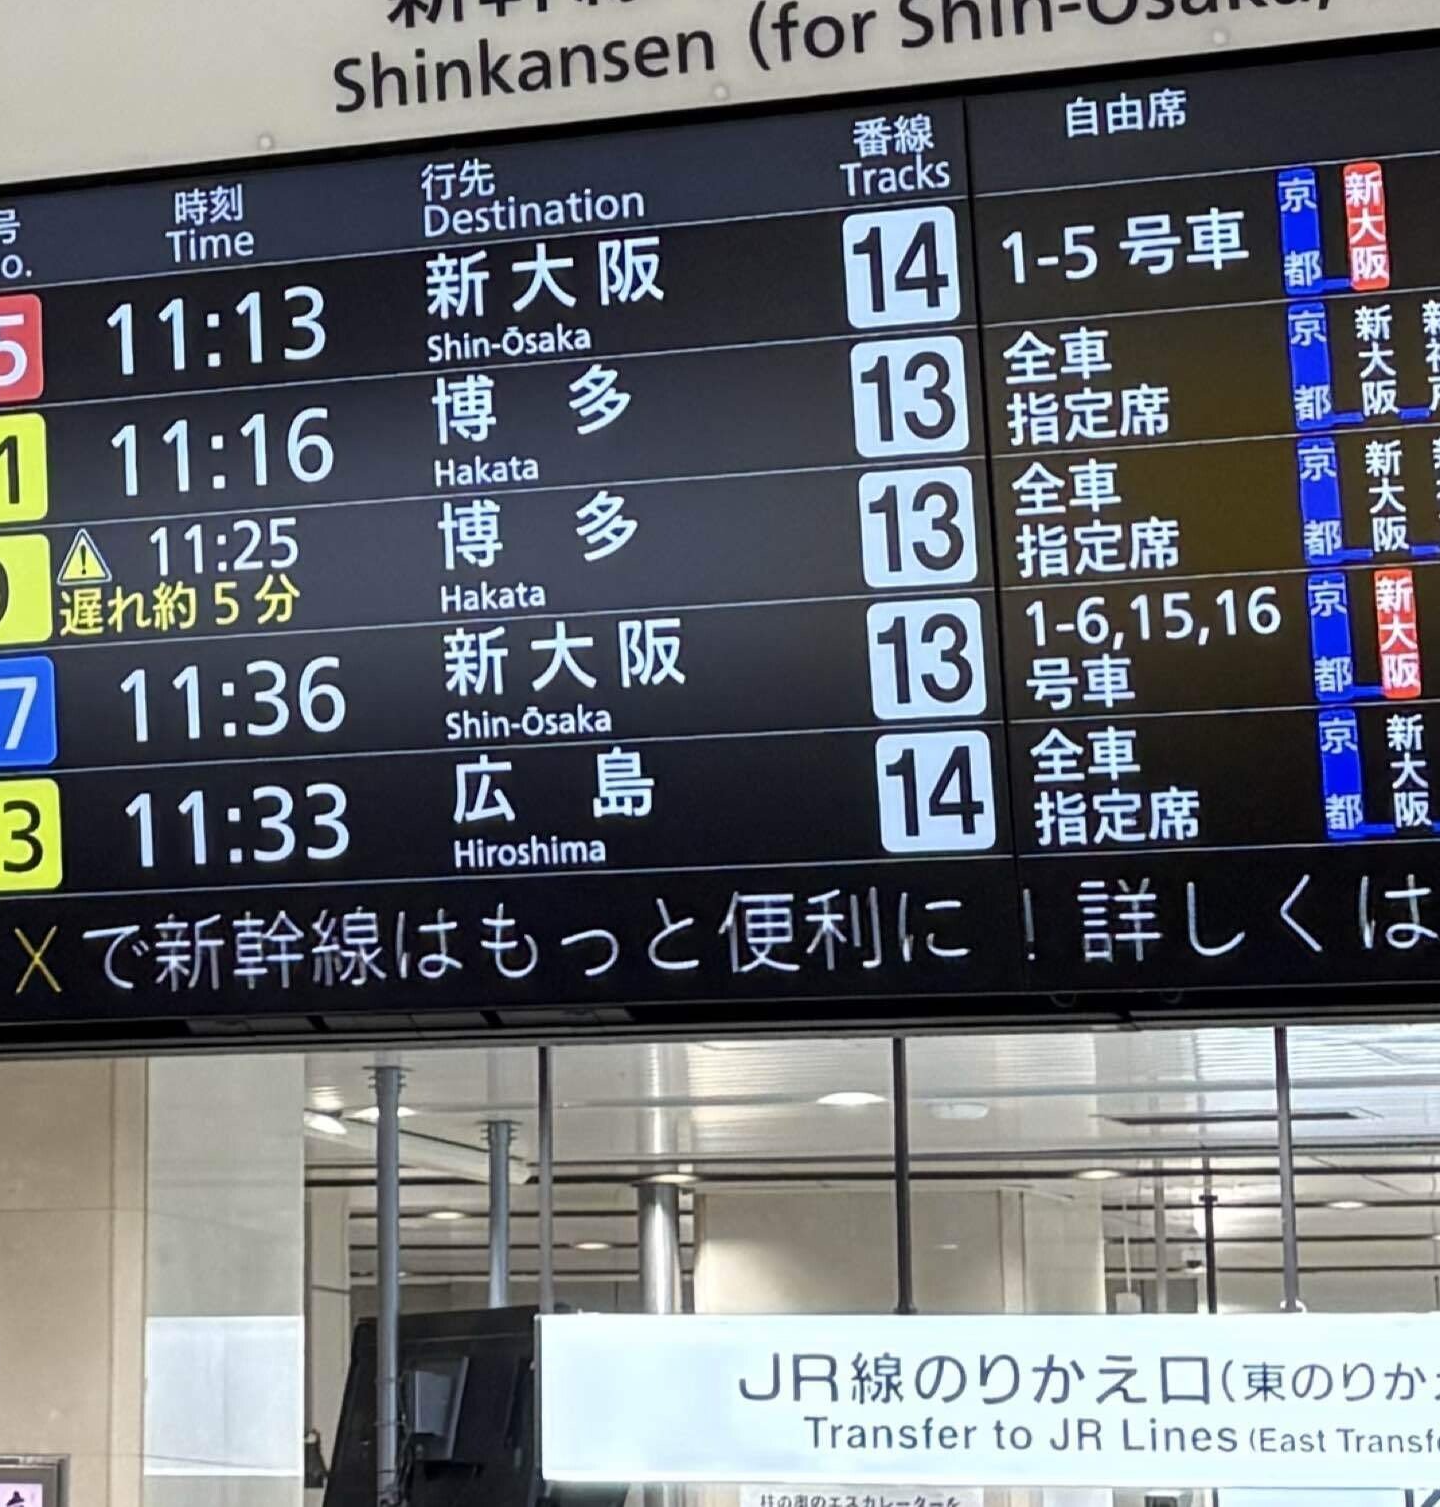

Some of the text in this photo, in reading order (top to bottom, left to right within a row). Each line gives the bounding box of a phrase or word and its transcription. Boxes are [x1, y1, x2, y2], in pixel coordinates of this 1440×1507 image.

[335, 25, 715, 114] Shinkansen
[853, 114, 934, 158] 番線
[1066, 89, 1187, 138] 自由席
[175, 184, 244, 226] 時刻
[421, 159, 496, 202] 行先
[840, 156, 950, 197] Tracks
[166, 227, 254, 263] Time
[424, 189, 645, 238] Destination
[1344, 171, 1389, 282] 新大阪
[852, 220, 949, 315] 14
[1002, 207, 1250, 285] 1-5 号車
[426, 236, 665, 320] 新大阪
[106, 284, 327, 377] 11:13
[427, 323, 592, 364] Shin-Ōsaka
[1002, 326, 1113, 386] 全車
[860, 351, 957, 444] 13
[1007, 382, 1170, 447] 指定席
[111, 406, 335, 497] 11:16
[433, 454, 539, 488] Hakata
[150, 516, 299, 578] 11:25
[868, 480, 965, 574] 13
[440, 581, 546, 614] Hakata
[1025, 585, 1281, 651] 1-6,15,16
[443, 616, 686, 696] 新大阪
[877, 613, 974, 706] 13
[1026, 654, 1136, 711] 号車
[120, 655, 347, 744] 11:36
[445, 703, 612, 742] Shin-Ōsaka
[885, 744, 985, 838] 14
[125, 782, 350, 869] 11:33
[453, 835, 607, 870] Hiroshima
[803, 1414, 977, 1452] Transfer
[995, 1419, 1034, 1452] to
[1049, 1418, 1103, 1453] JR
[1123, 1416, 1238, 1455] Lines
[1248, 1427, 1326, 1456] (East
